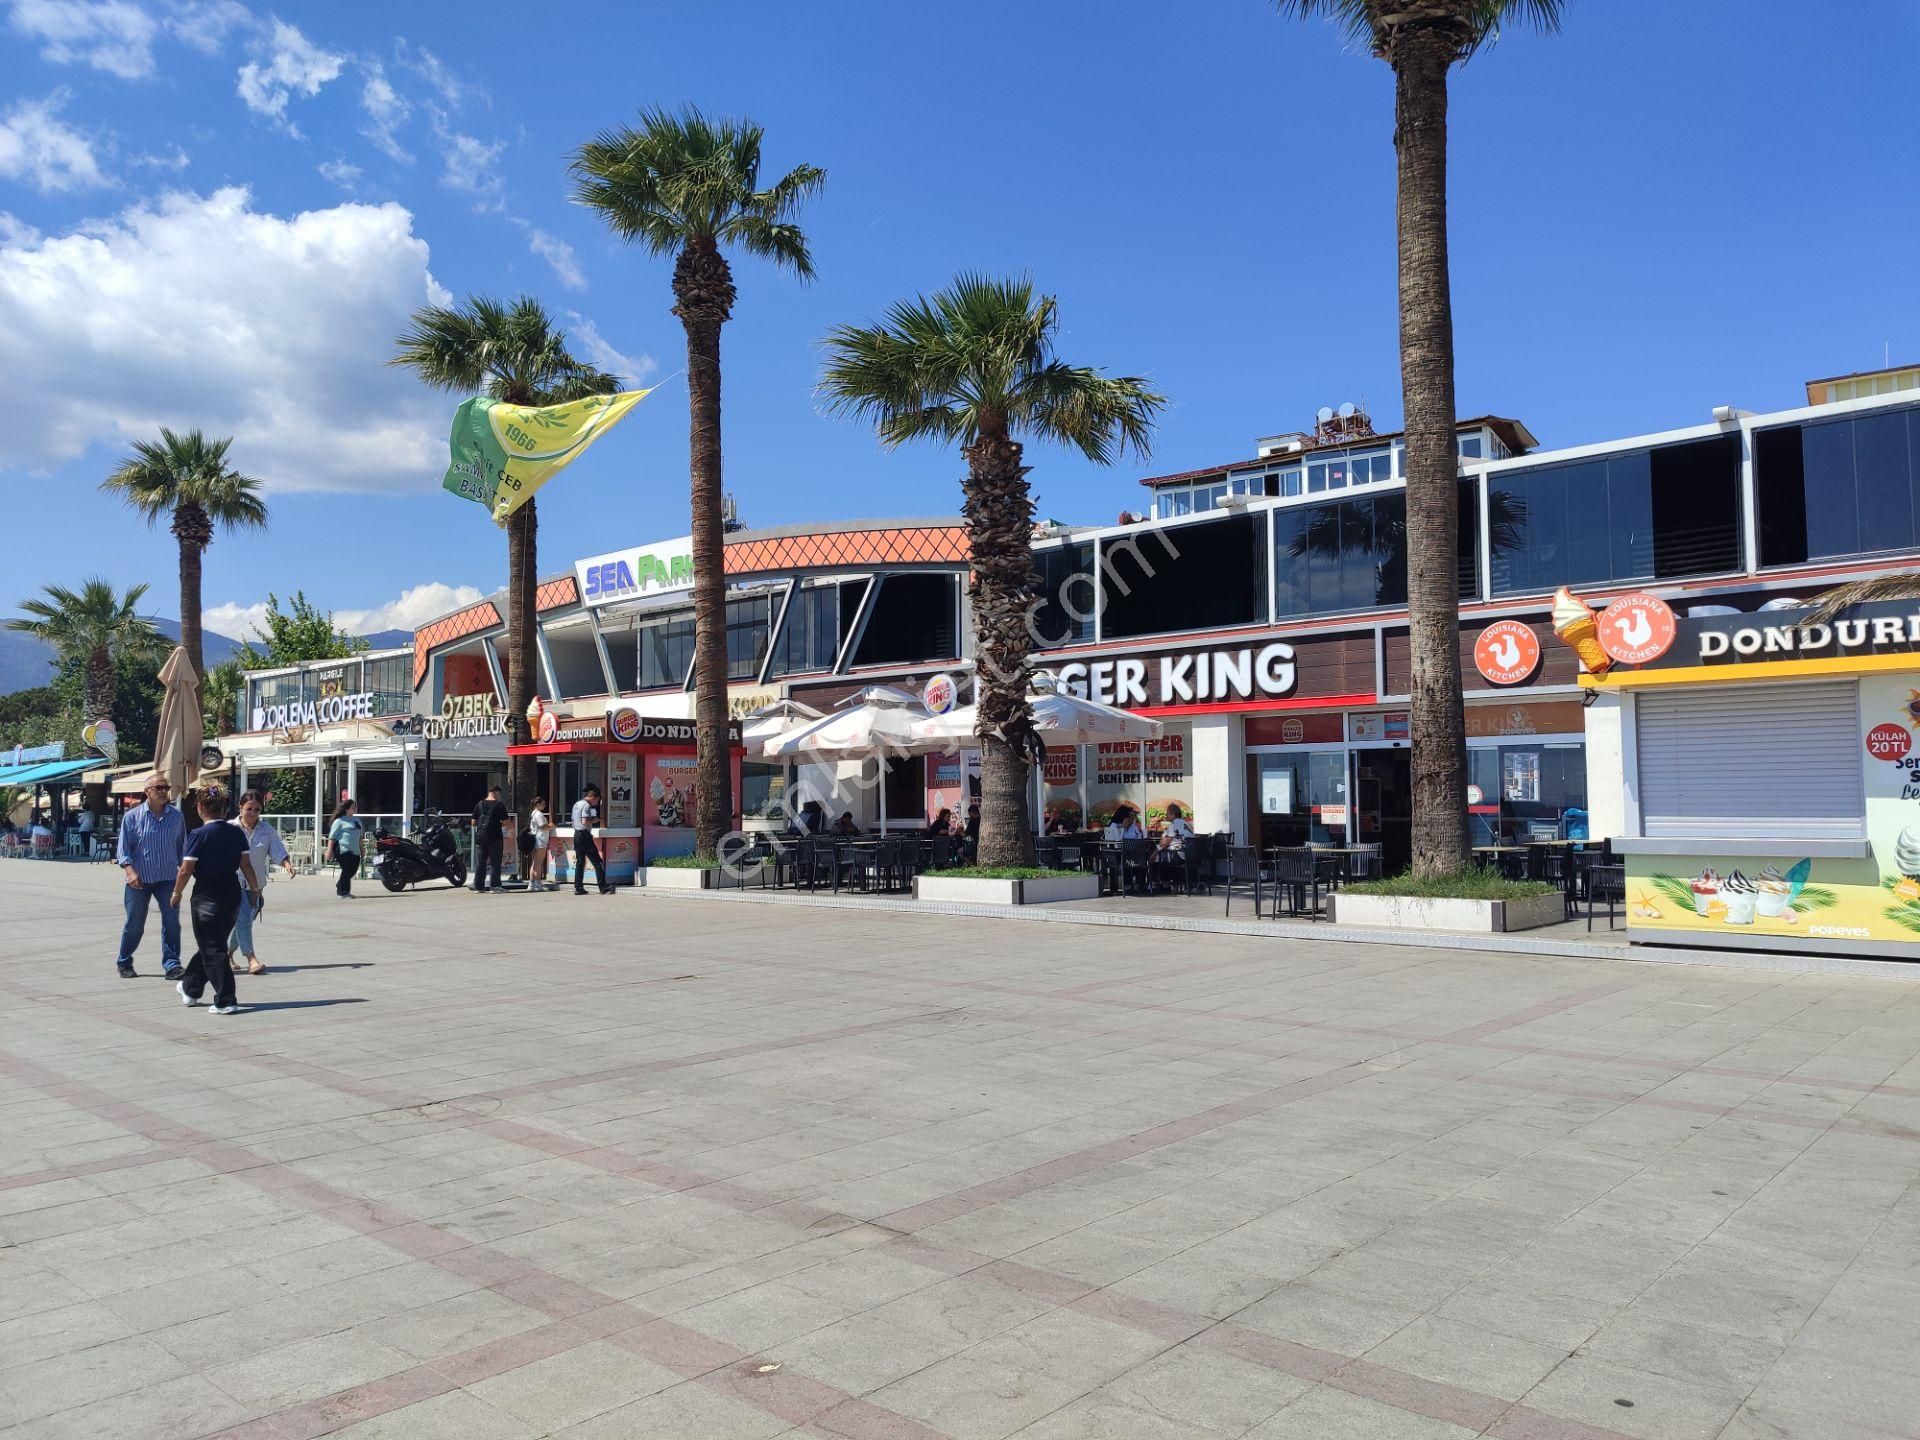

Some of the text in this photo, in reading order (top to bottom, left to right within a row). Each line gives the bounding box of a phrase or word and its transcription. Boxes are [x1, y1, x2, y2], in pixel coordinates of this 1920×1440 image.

[505, 423, 537, 451] 1966
[585, 560, 634, 595] SEA
[1608, 597, 1664, 618] LOUISIANA
[1482, 624, 1529, 643] LOUISIANA
[1610, 643, 1660, 660] KITCHEN
[1056, 643, 1296, 705] GER KING
[1487, 665, 1528, 681] KITCHEN
[928, 690, 950, 705] KING
[318, 692, 374, 723] COFFEE
[422, 714, 509, 740] KUYUMCULUK
[616, 713, 637, 726] BURGER
[617, 720, 640, 734] KING
[556, 727, 602, 740] DONDURMA
[1871, 731, 1907, 741] KÜLAH
[1872, 741, 1908, 753] 20 TL
[1045, 754, 1076, 764] BURGER
[1045, 764, 1076, 777] KING
